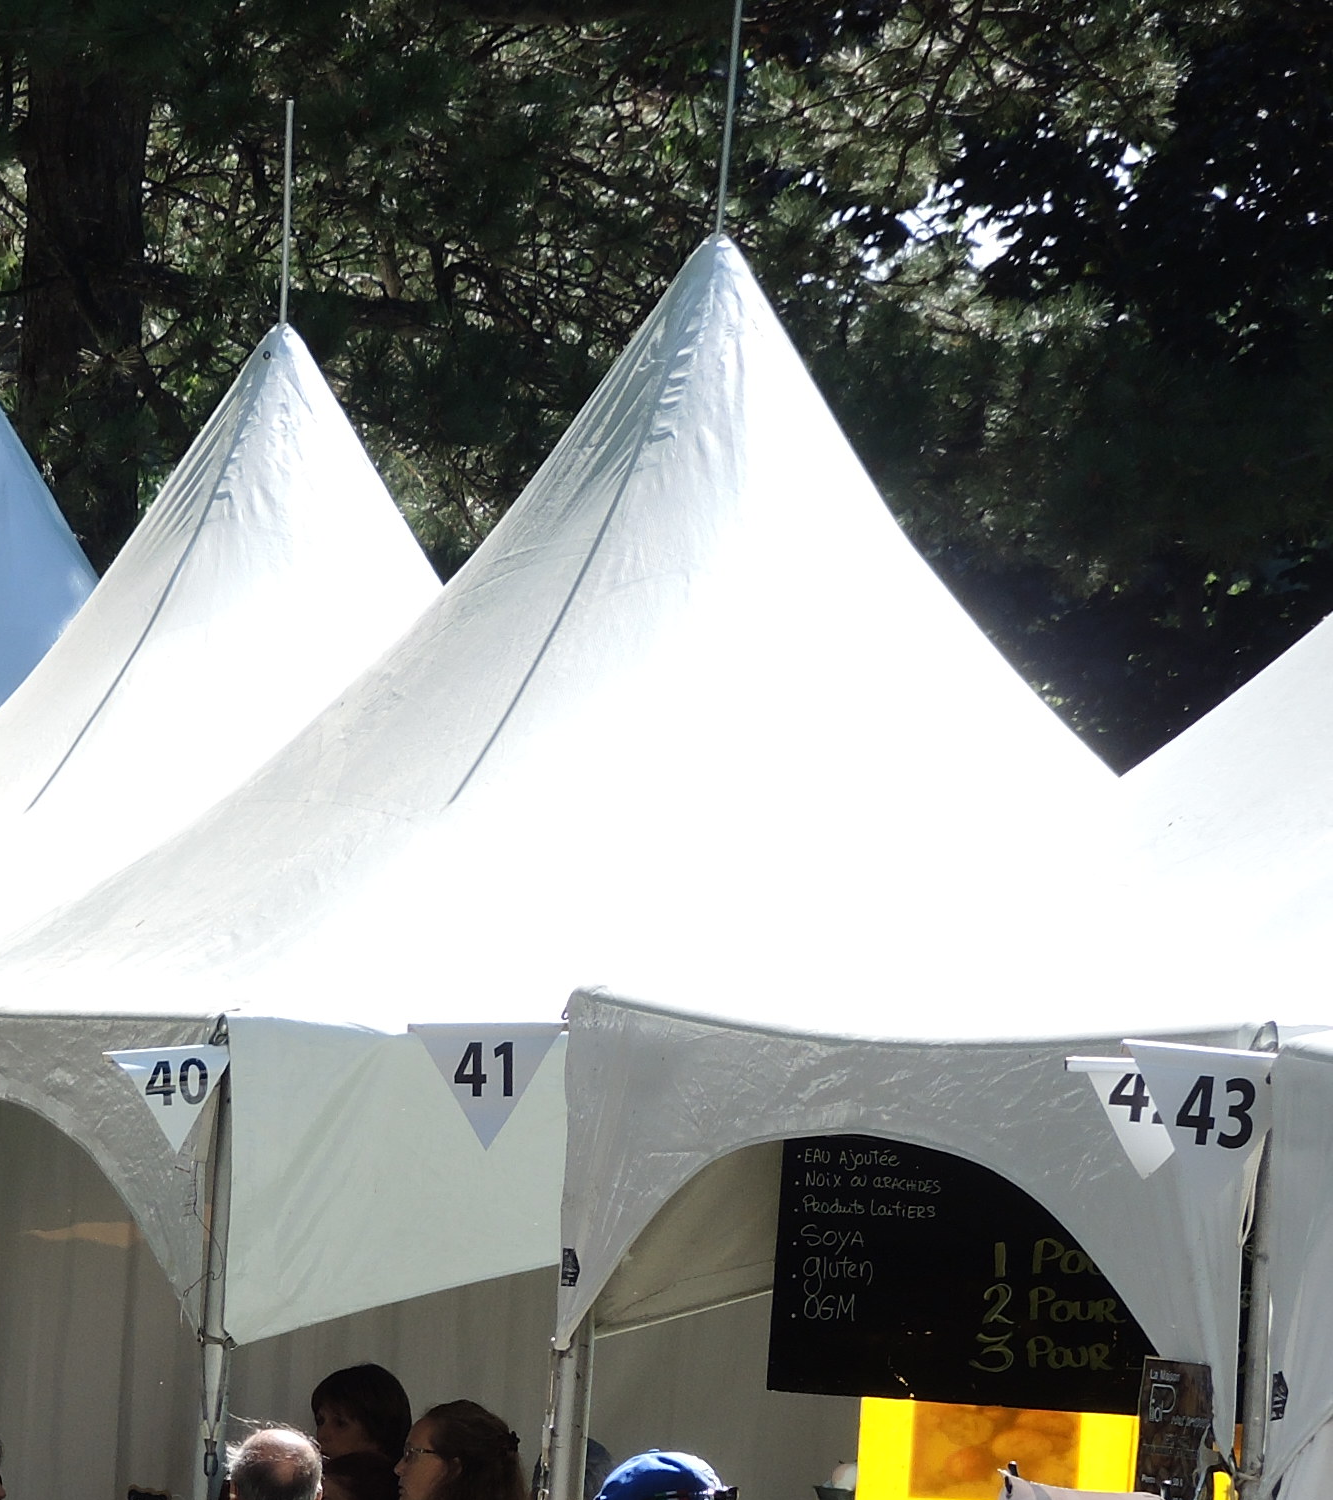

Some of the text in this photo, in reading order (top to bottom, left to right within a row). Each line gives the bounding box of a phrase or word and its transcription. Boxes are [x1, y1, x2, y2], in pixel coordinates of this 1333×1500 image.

[145, 1058, 209, 1106] 40
[454, 1041, 514, 1097] 41
[1109, 1073, 1164, 1124] 4
[1176, 1075, 1256, 1149] 43
[804, 1148, 831, 1164] EAU
[994, 1241, 1007, 1278] 1
[803, 1293, 856, 1322] OGM
[983, 1283, 1015, 1325] 2
[968, 1332, 1015, 1374] 3
